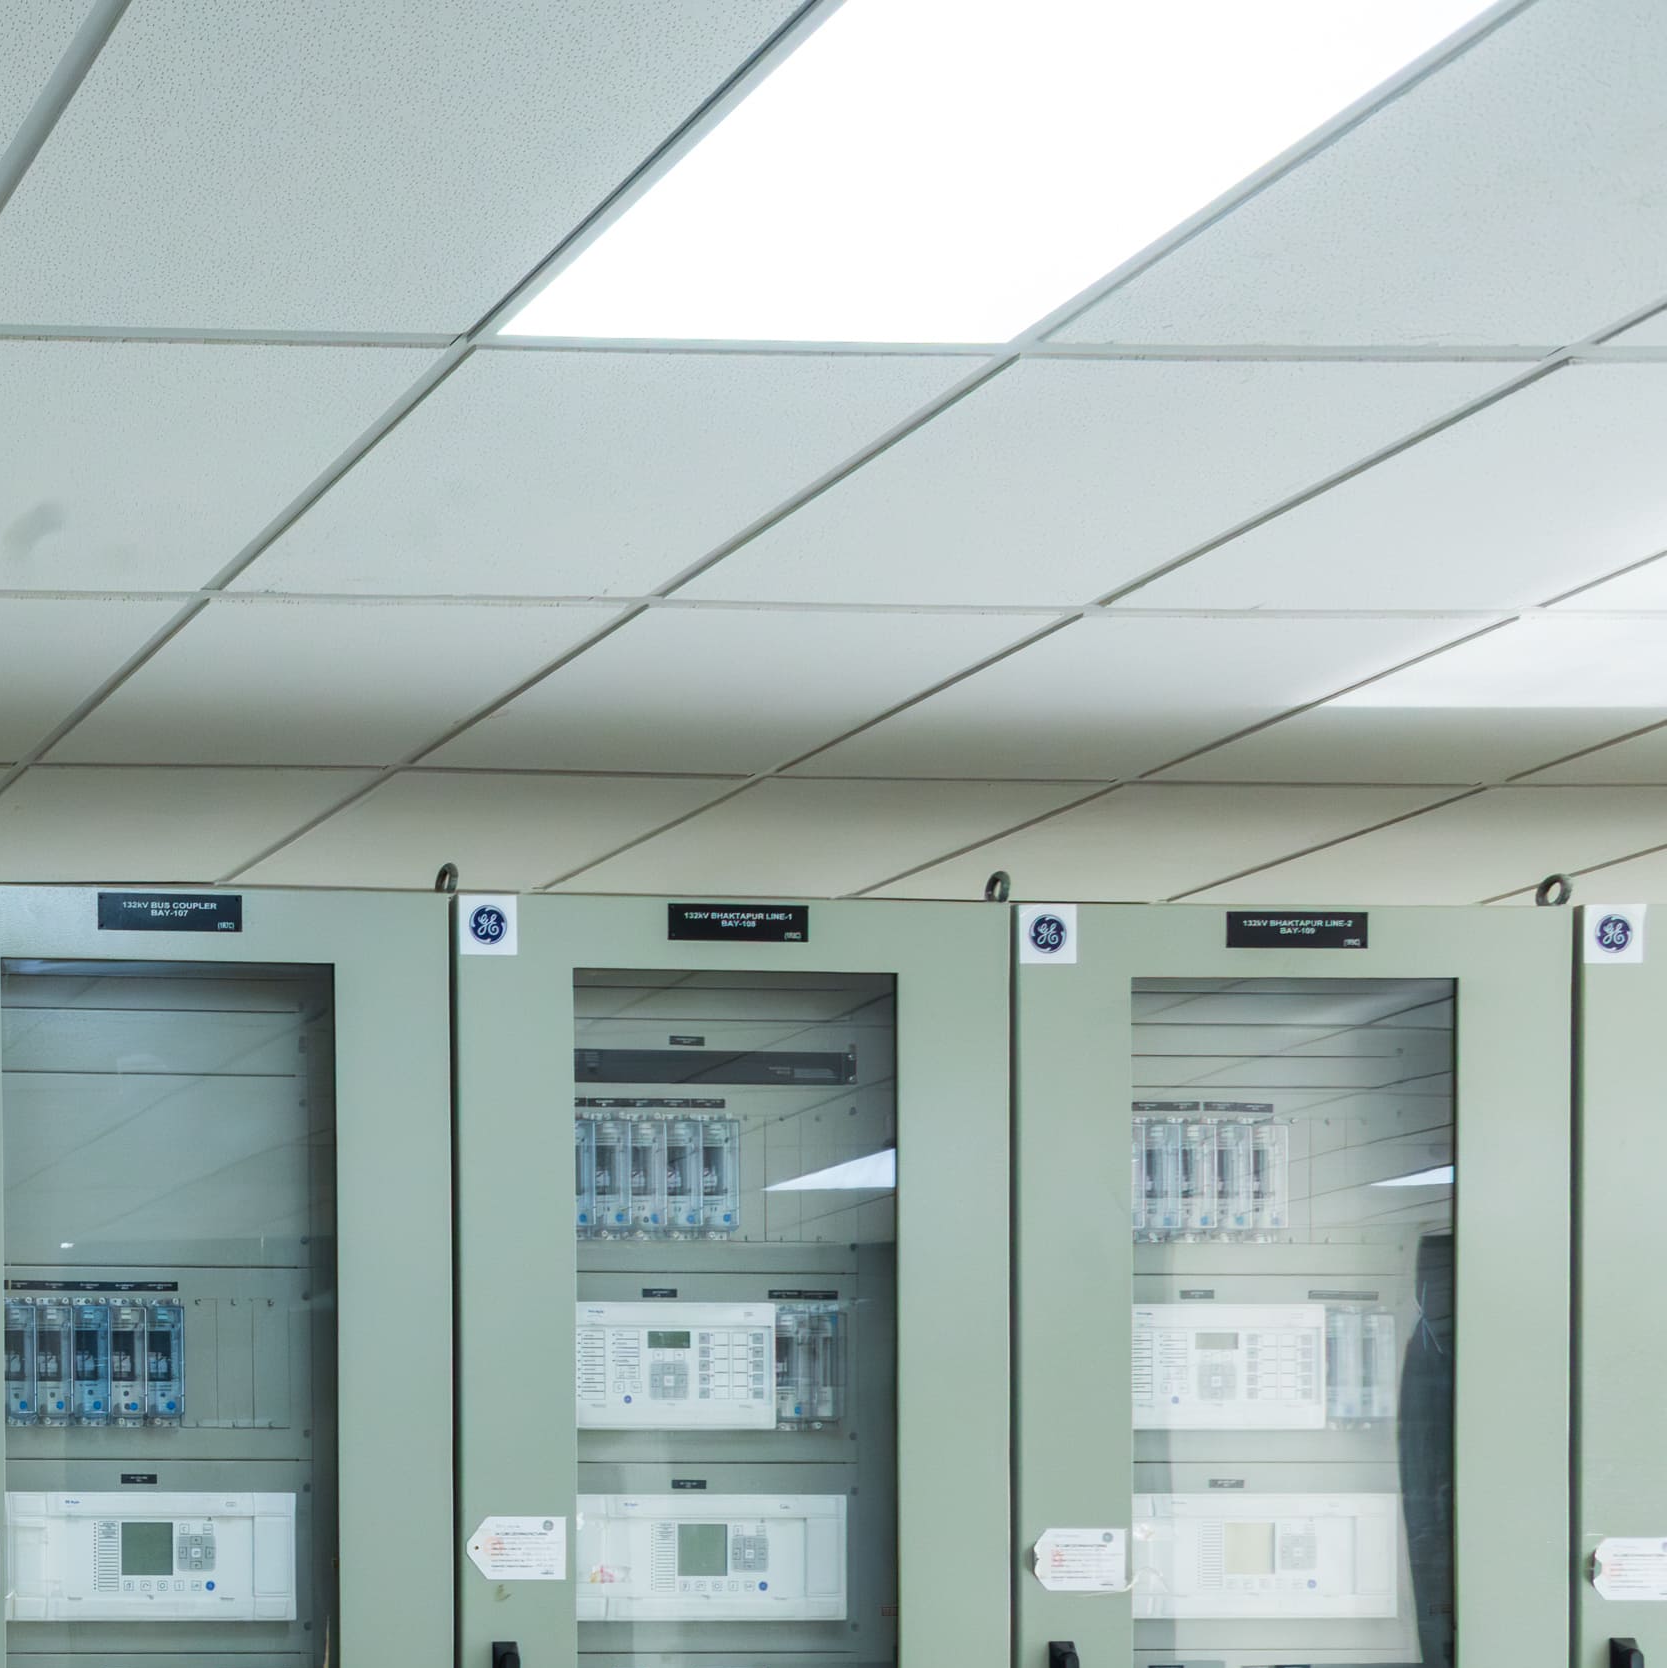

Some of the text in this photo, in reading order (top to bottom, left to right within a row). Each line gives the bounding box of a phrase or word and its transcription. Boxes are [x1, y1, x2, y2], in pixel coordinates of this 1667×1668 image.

[123, 901, 149, 909] 132kV
[172, 902, 217, 910] COUPLER
[684, 912, 710, 920] 132kV
[711, 912, 764, 920] BHAKTAPUR
